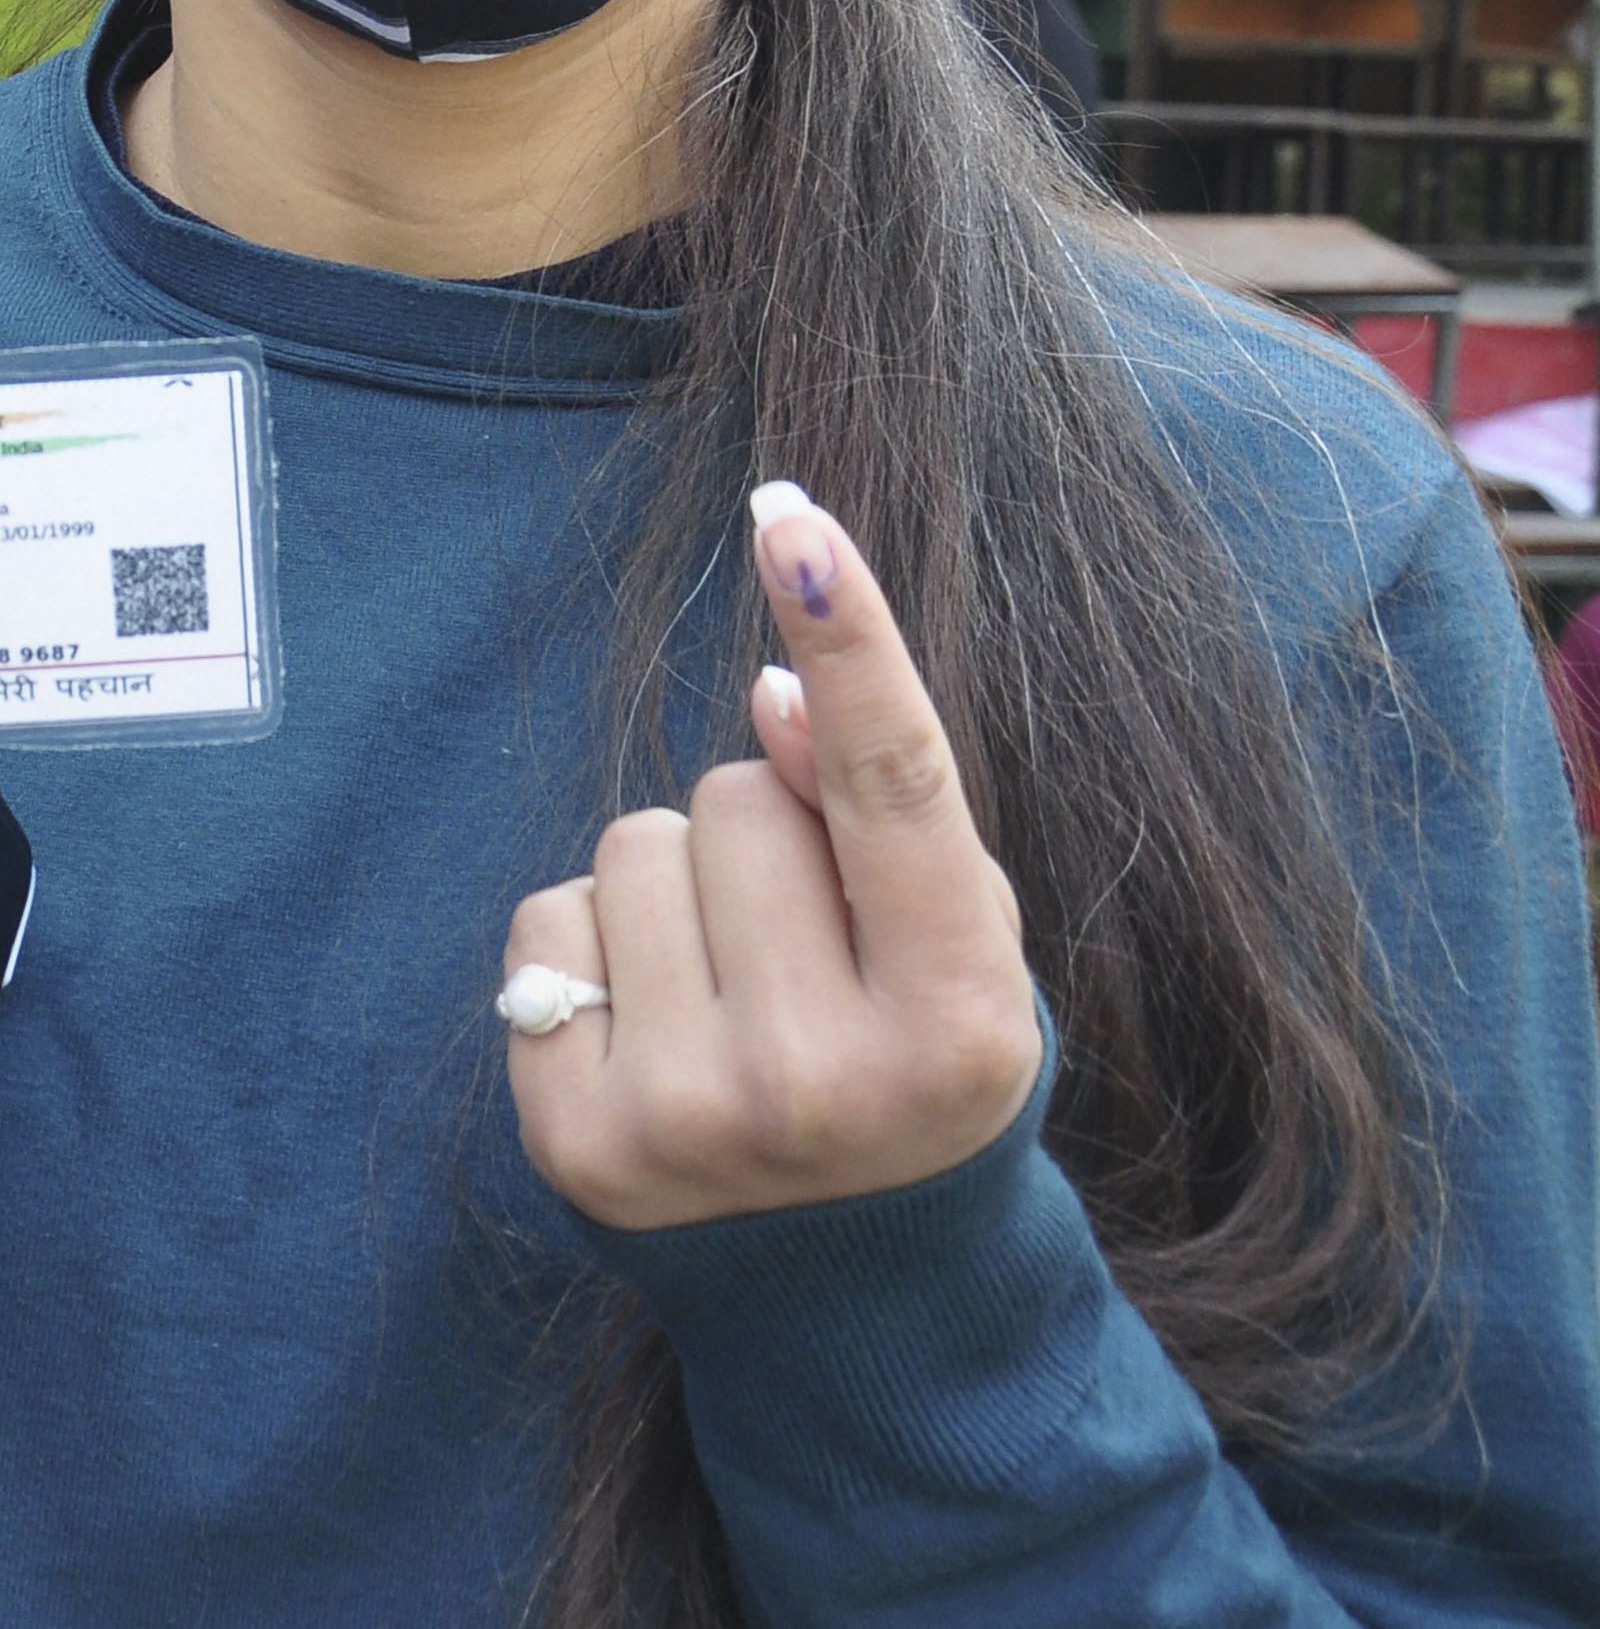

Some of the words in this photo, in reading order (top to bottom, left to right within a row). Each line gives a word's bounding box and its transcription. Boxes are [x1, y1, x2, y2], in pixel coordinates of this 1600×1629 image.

[1, 440, 44, 456] India
[20, 643, 81, 663] 9687
[56, 671, 155, 702] पहचान
